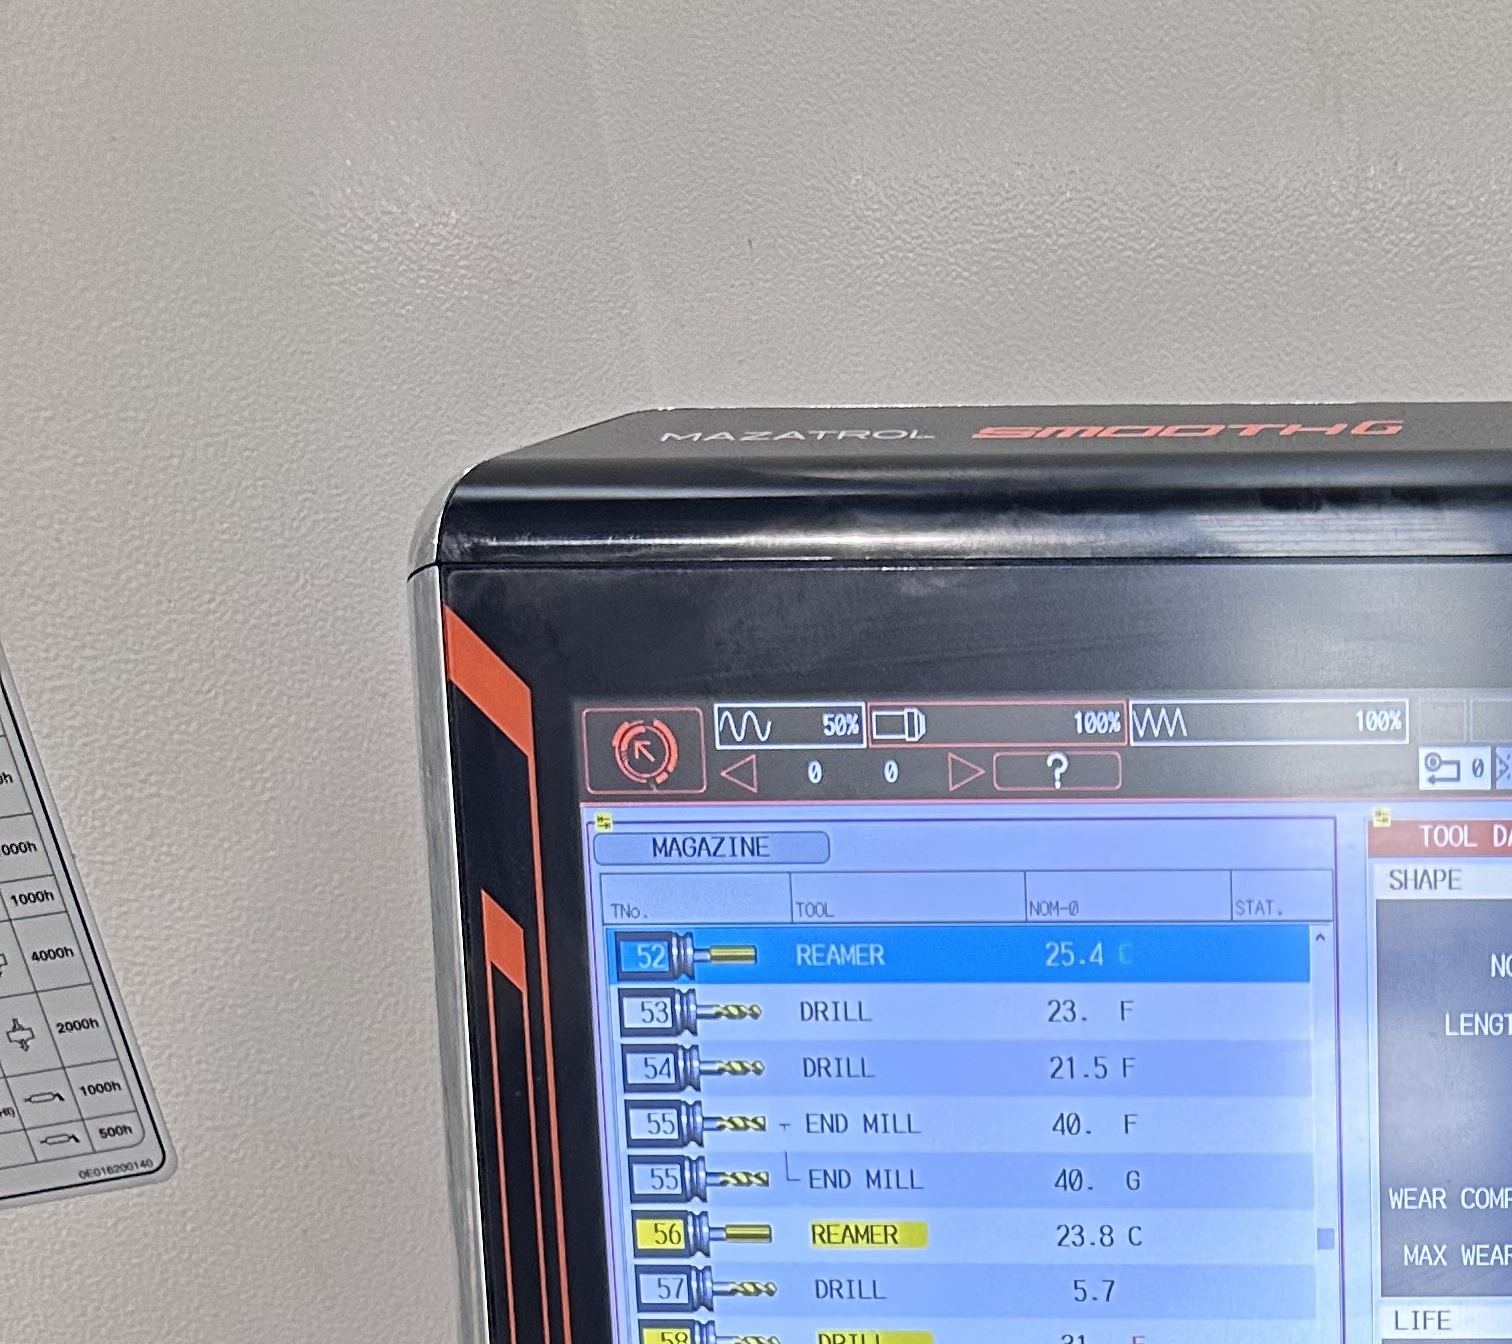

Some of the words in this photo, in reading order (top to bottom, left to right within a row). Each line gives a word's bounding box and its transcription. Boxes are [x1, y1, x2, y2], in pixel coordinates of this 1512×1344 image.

[661, 430, 935, 442] MAZATROL
[822, 714, 860, 736] 50%
[1074, 711, 1121, 734] 100%
[1357, 710, 1404, 732] 100%
[652, 835, 770, 858] MAGAZINE
[1419, 825, 1478, 848] TOOL
[0, 841, 38, 858] 000h
[1389, 869, 1462, 890] SHAPE
[10, 889, 55, 907] 1000h
[1235, 900, 1282, 916] STAT.
[610, 902, 649, 919] TNo.
[796, 902, 835, 918] TOOL
[31, 946, 74, 962] 4000h
[637, 944, 666, 967] 52
[796, 944, 885, 966] REAMER
[1045, 941, 1104, 967] 25.4
[800, 1001, 873, 1022] DRILL
[56, 1017, 100, 1034] 2000h
[802, 1057, 876, 1078] DRILL
[1049, 1056, 1108, 1079] 21.5
[80, 1081, 122, 1097] 1000h
[98, 1123, 133, 1140] 500h
[647, 1113, 675, 1135] 55
[805, 1113, 848, 1134] END
[864, 1113, 922, 1134] MILL
[809, 1169, 851, 1189] END
[867, 1169, 924, 1189] MILL
[1389, 1188, 1447, 1209] WEAR
[653, 1223, 681, 1245] 56
[811, 1224, 899, 1245] REAMER
[1056, 1224, 1114, 1247] 23.8
[1404, 1245, 1447, 1266] MAX
[815, 1280, 887, 1300] DRILL
[1073, 1279, 1116, 1302] 5.7
[1394, 1311, 1451, 1330] LIFE
